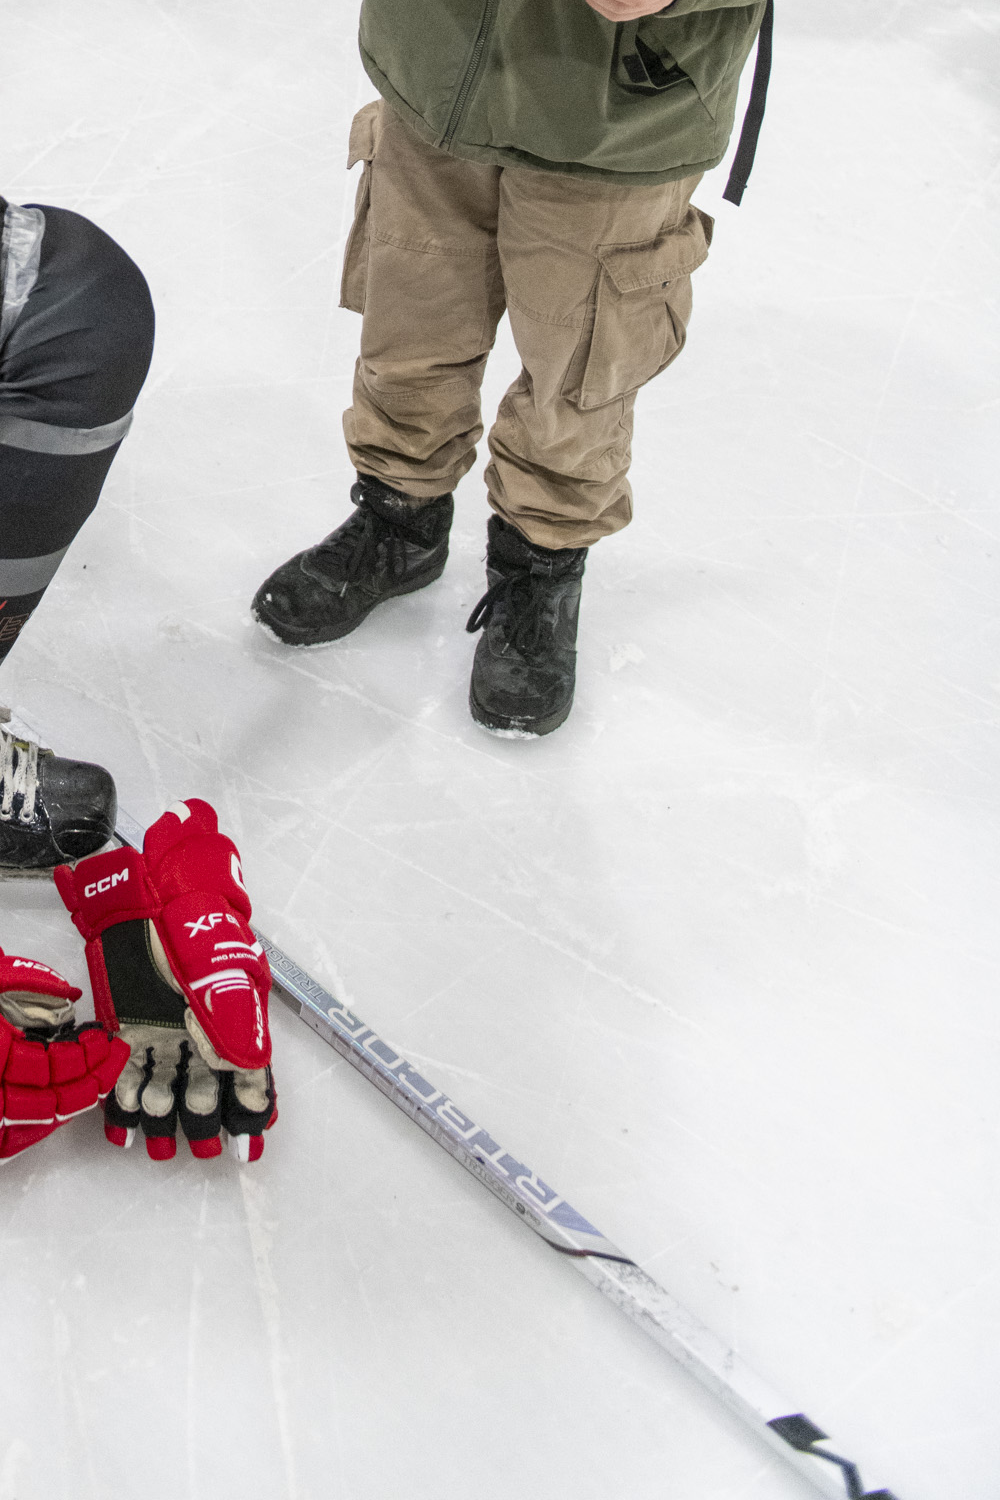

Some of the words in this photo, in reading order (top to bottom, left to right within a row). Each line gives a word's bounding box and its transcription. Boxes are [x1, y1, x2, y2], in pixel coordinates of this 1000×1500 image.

[84, 867, 129, 898] CCM
[183, 912, 223, 938] XF
[327, 1004, 564, 1212] RIBCOR
